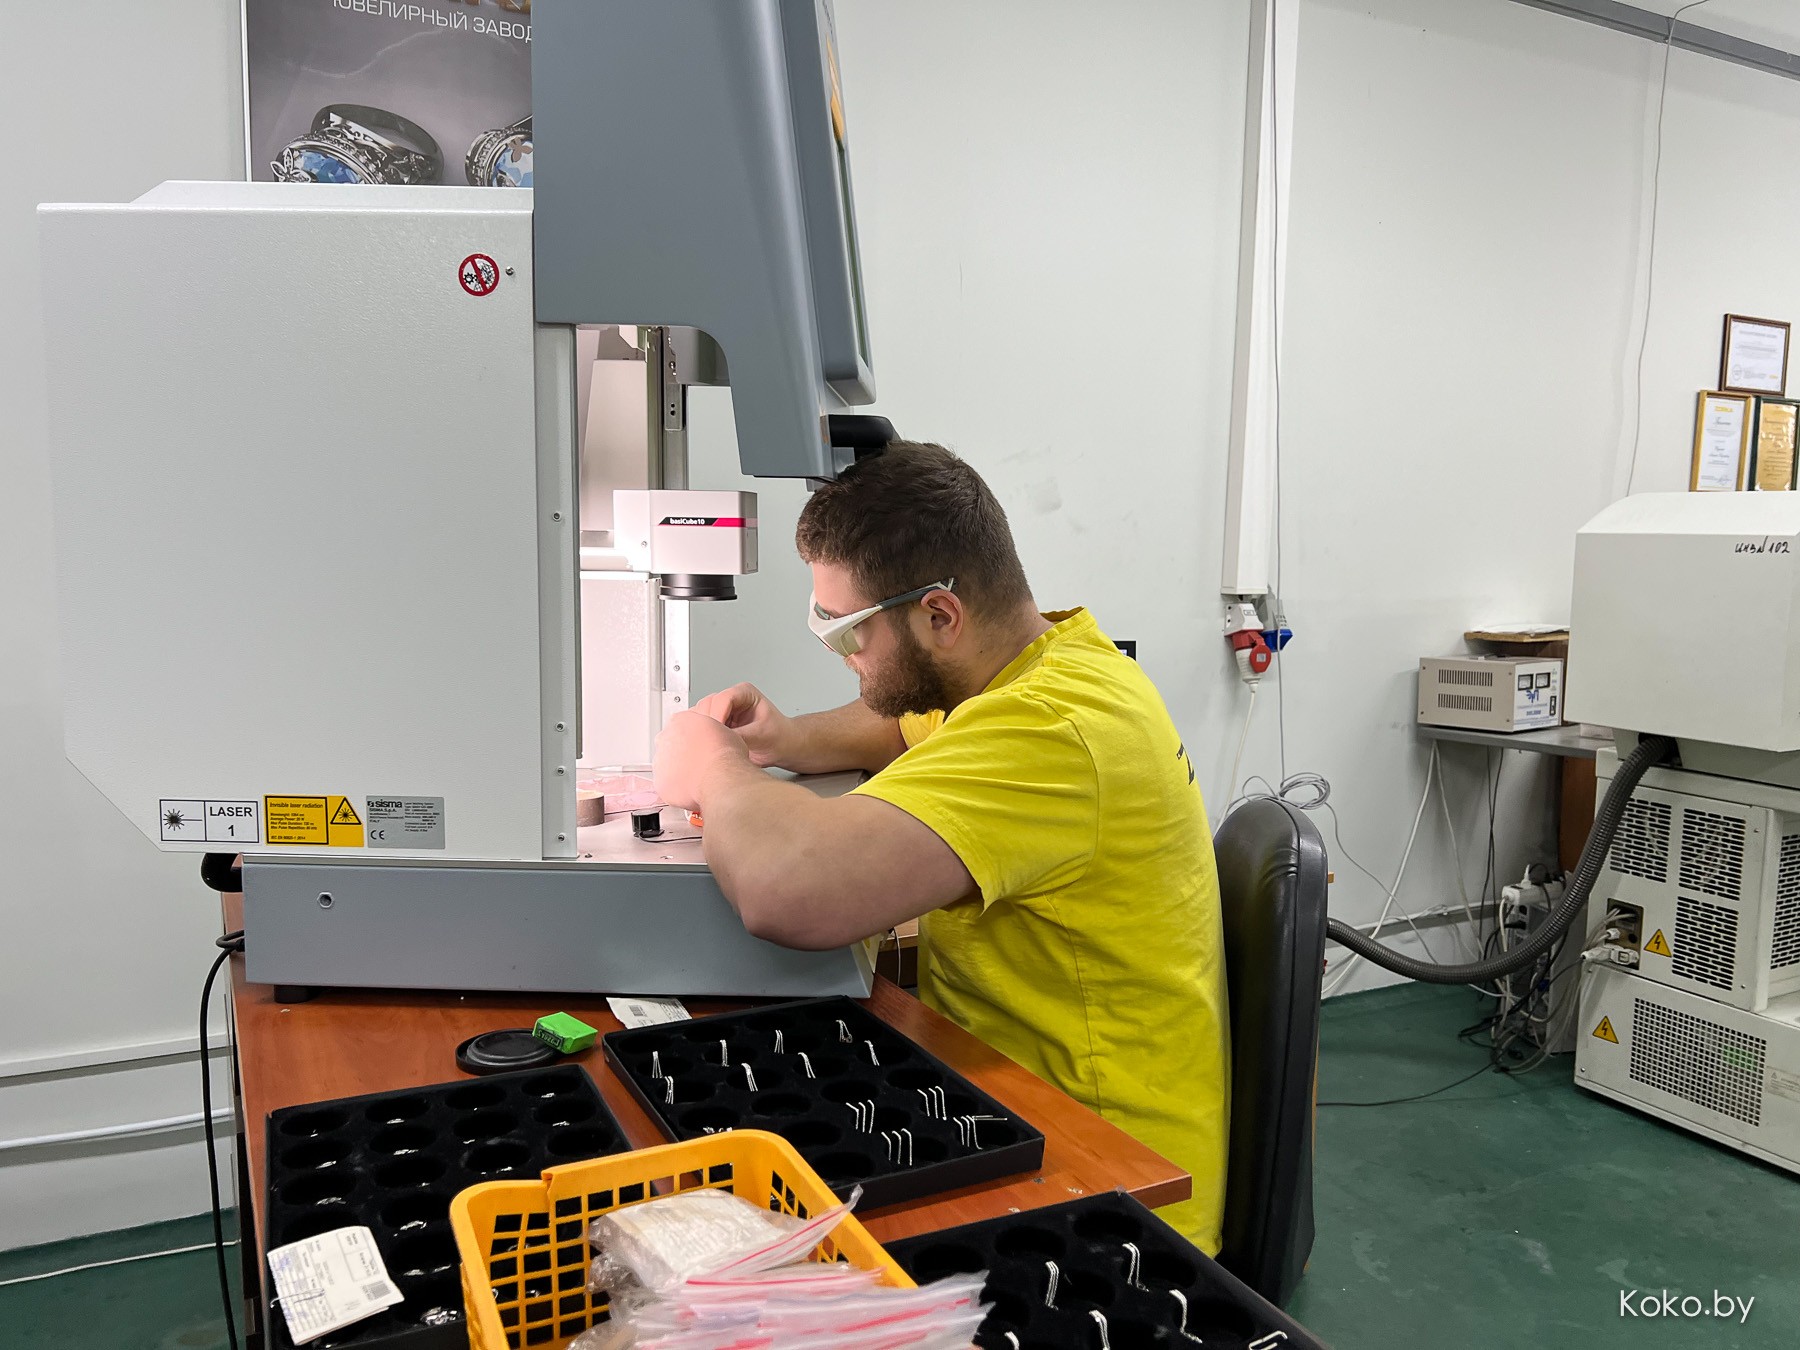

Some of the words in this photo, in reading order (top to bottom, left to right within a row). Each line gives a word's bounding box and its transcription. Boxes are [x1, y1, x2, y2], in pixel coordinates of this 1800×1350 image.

[1769, 541, 1791, 554] 102
[375, 799, 402, 808] sisma
[209, 806, 253, 818] LASER
[228, 824, 235, 837] 1
